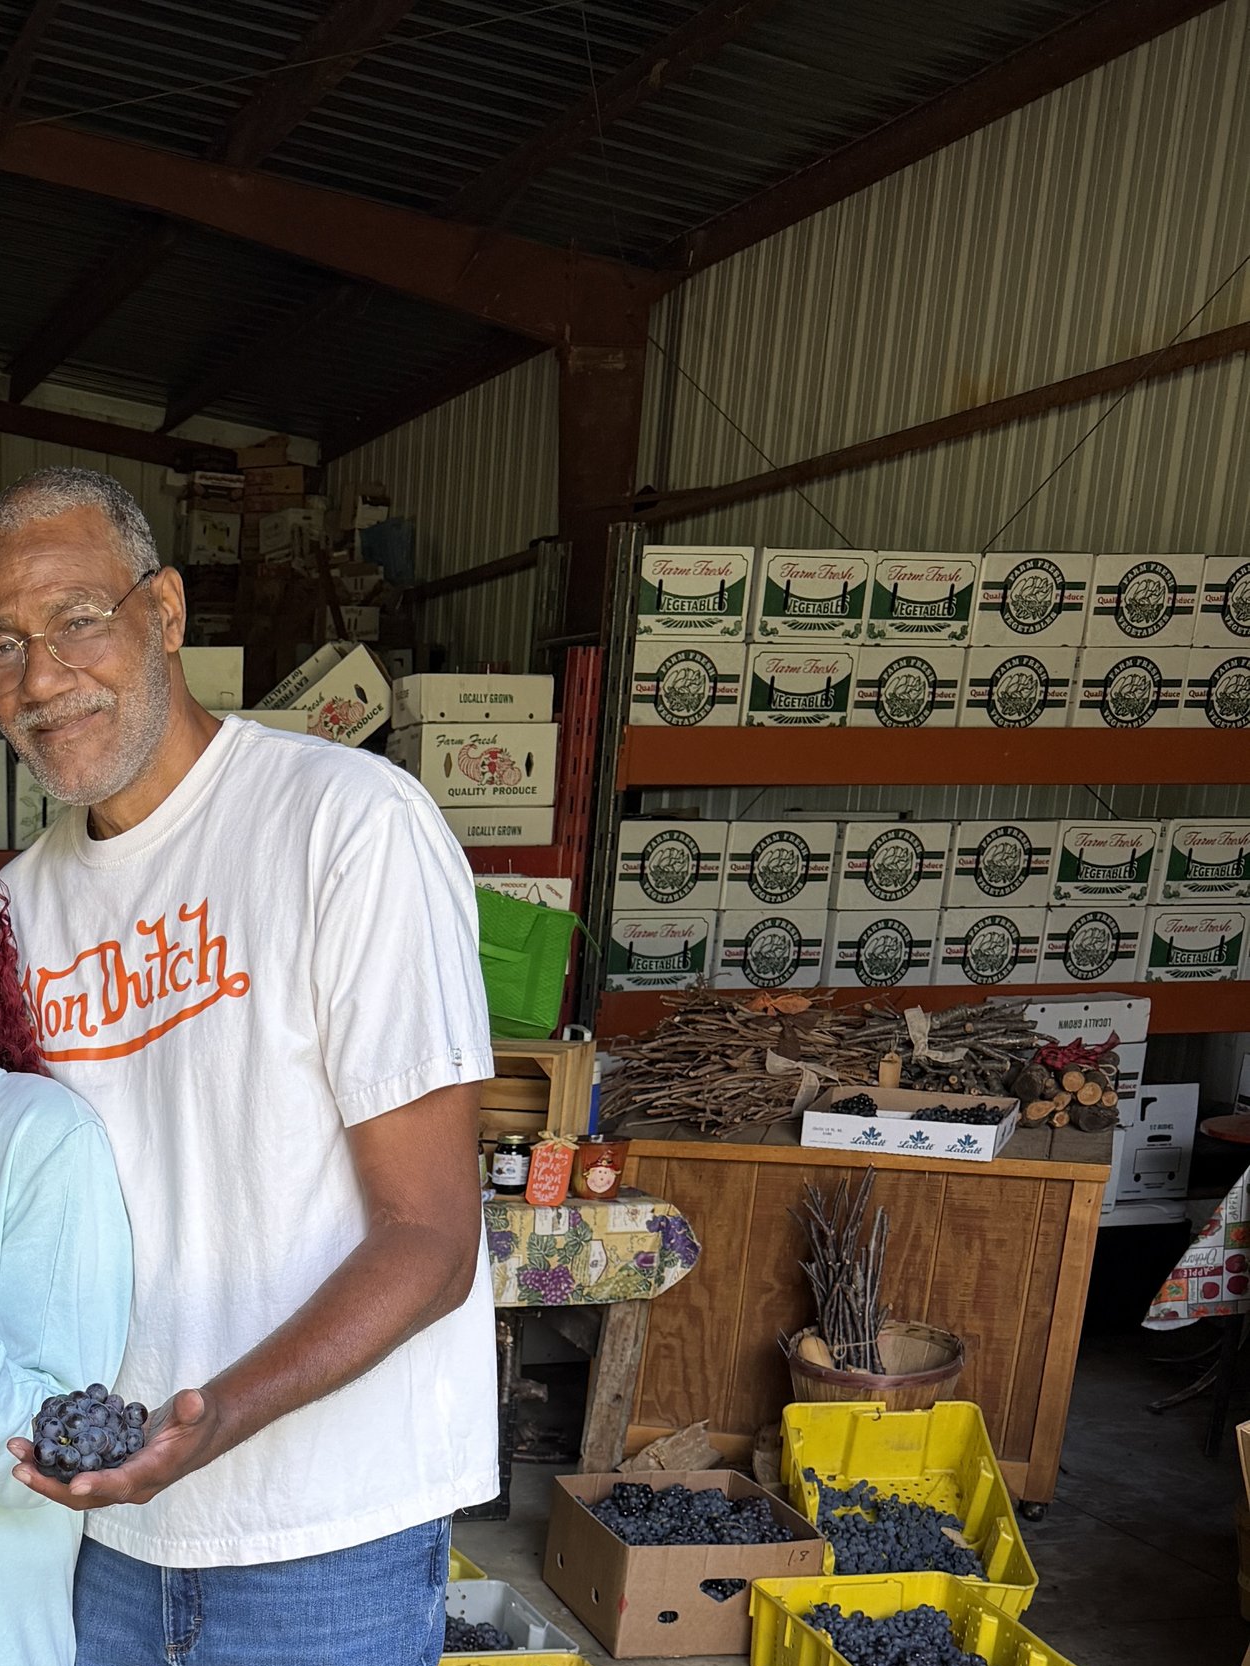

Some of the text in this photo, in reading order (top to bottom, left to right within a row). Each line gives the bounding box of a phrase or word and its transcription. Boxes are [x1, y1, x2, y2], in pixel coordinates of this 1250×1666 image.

[652, 560, 732, 577] Farm Fresh
[779, 562, 854, 581] Farm Fresh
[888, 565, 961, 583] Farm Fresh
[765, 658, 839, 675] Farm Fresh
[459, 693, 514, 704] LOCALLY GROWN
[346, 702, 385, 739] PRODUCE
[436, 734, 498, 747] Farm Fresh
[448, 786, 537, 797] QUALITY PRODUCE
[467, 826, 496, 837] LOCALLY
[1074, 833, 1142, 847] Farm Fresh
[1183, 832, 1250, 847] Farm Fresh
[1164, 919, 1232, 933] Farm Fresh
[21, 897, 250, 1042] Von Dutch
[850, 1136, 887, 1147] Labatt
[896, 1140, 935, 1151] Labatt
[944, 1143, 983, 1155] Labatt
